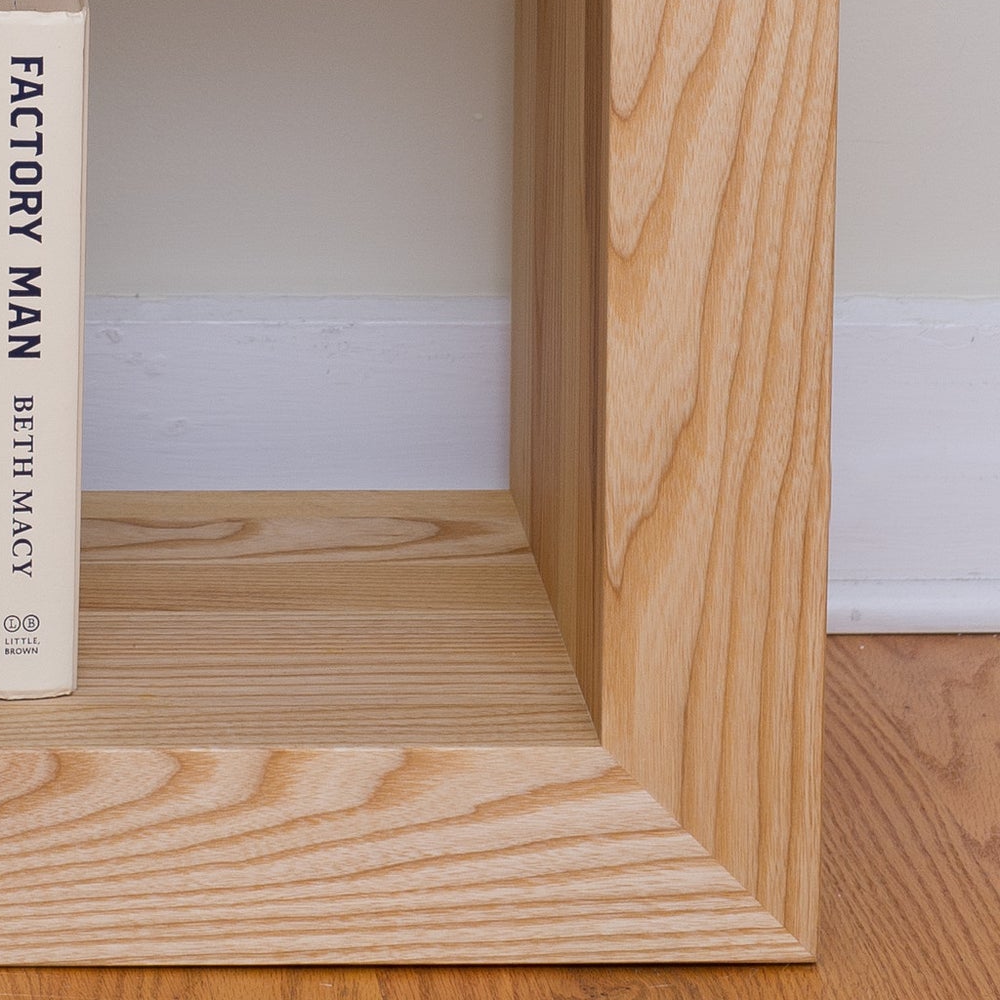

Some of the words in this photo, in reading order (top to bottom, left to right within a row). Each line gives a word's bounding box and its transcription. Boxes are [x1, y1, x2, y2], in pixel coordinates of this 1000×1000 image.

[8, 56, 44, 244] FACTORY
[7, 266, 42, 359] MAN
[12, 395, 34, 478] BETH
[11, 489, 33, 578] MACY
[4, 637, 41, 646] LITTLE,
[4, 647, 39, 656] BROWN
